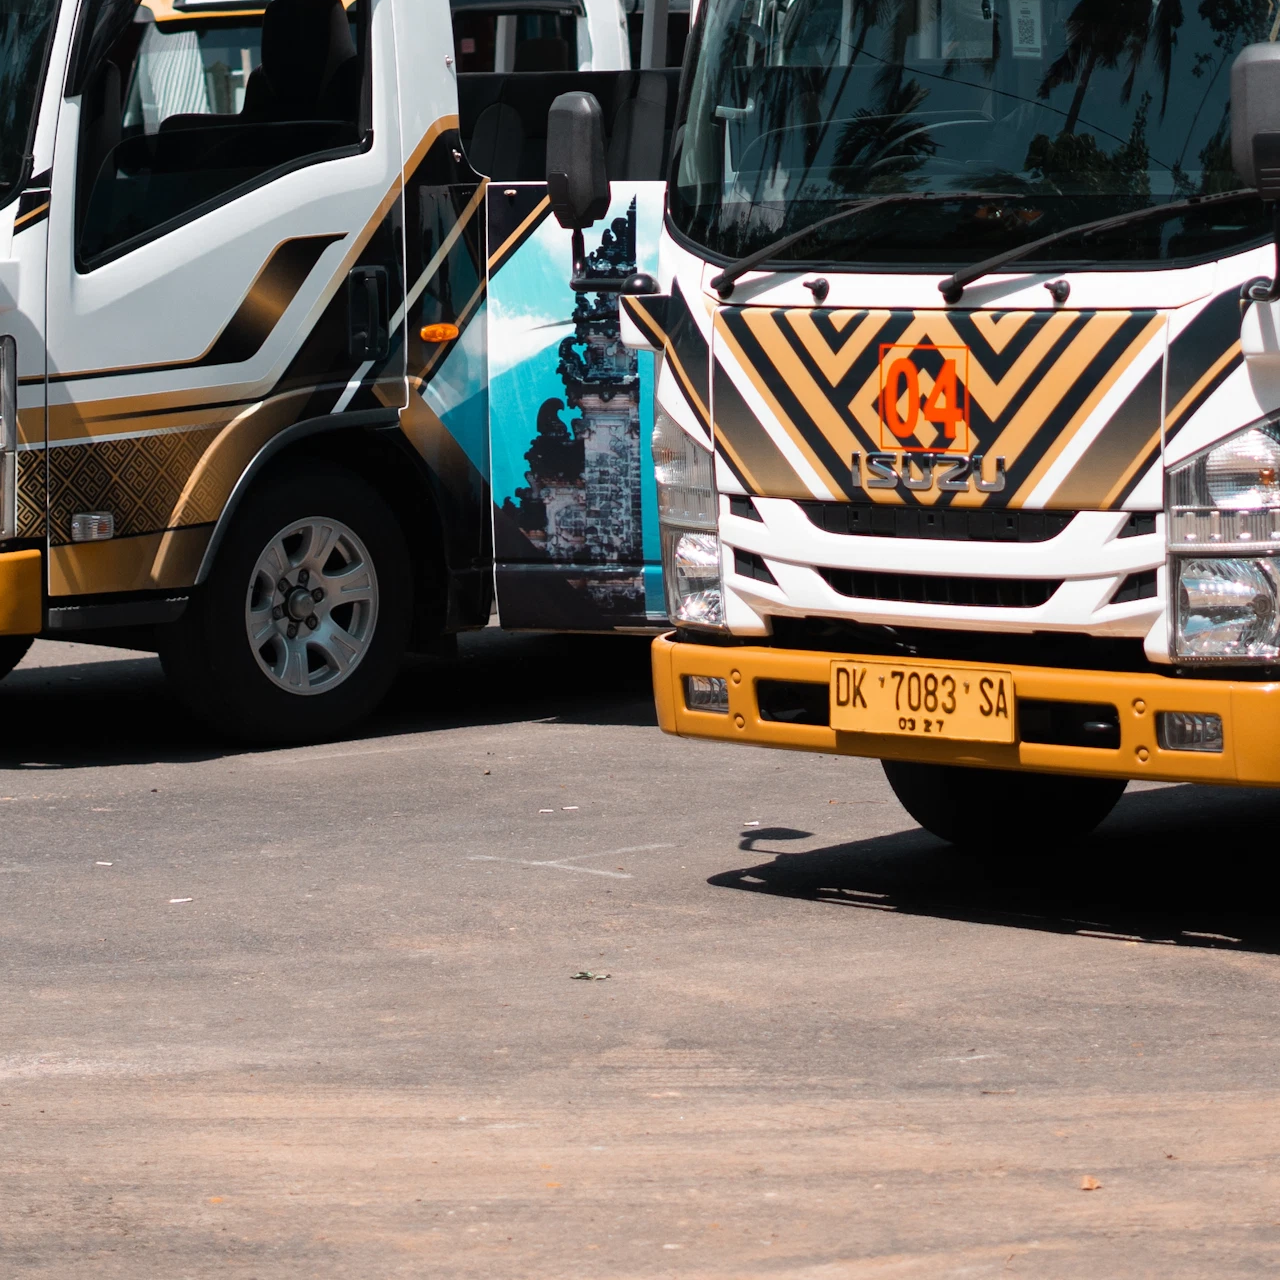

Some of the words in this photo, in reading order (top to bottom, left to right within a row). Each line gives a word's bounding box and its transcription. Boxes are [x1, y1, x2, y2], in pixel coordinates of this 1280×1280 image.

[885, 358, 963, 438] 04
[851, 451, 1006, 492] ISUZU
[836, 667, 867, 709] DK
[891, 670, 956, 714] 7083
[979, 677, 1008, 718] SA
[898, 717, 916, 731] 03
[923, 719, 944, 732] 27
